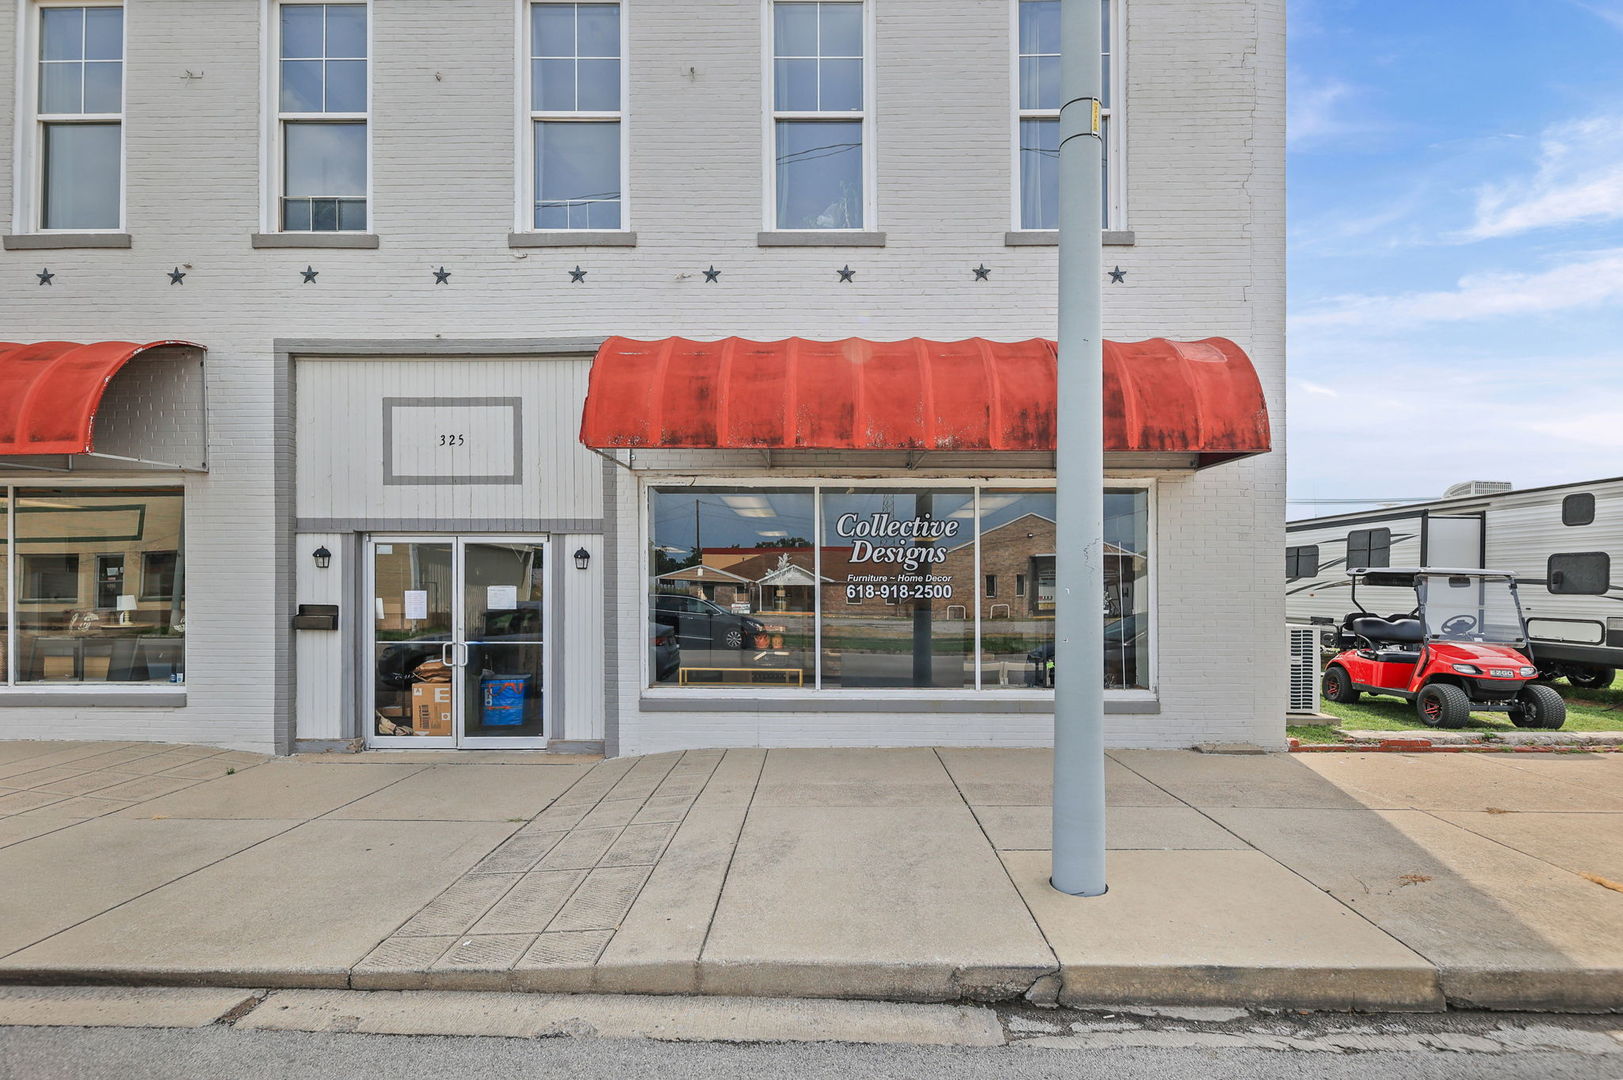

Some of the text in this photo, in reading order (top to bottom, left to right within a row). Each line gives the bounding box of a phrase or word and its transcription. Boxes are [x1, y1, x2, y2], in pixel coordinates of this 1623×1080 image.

[439, 434, 464, 447] 325
[837, 512, 959, 537] Collective
[848, 540, 947, 571] Designs
[847, 574, 888, 582] Furniture
[897, 574, 923, 582] Home
[925, 574, 952, 582] Decor
[846, 585, 953, 599] 618-918-2500
